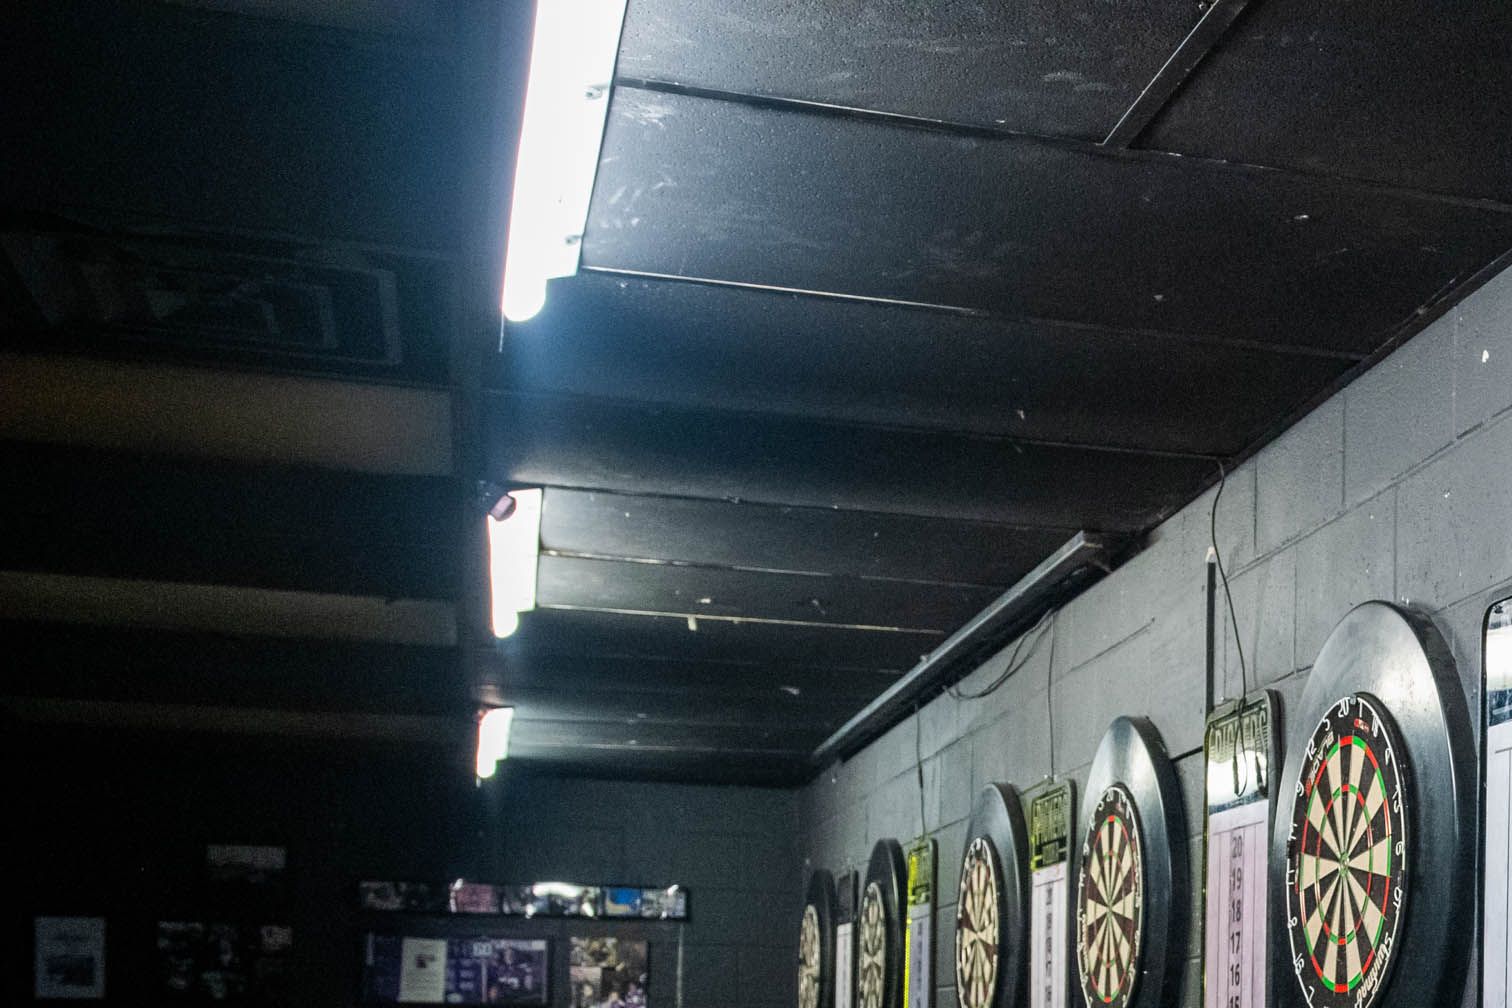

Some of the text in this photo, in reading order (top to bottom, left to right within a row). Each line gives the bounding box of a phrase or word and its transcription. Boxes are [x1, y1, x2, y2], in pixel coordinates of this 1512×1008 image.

[1231, 867, 1242, 890] 19
[1231, 899, 1242, 922] 18
[1230, 931, 1241, 954] 17
[1230, 963, 1240, 986] 16
